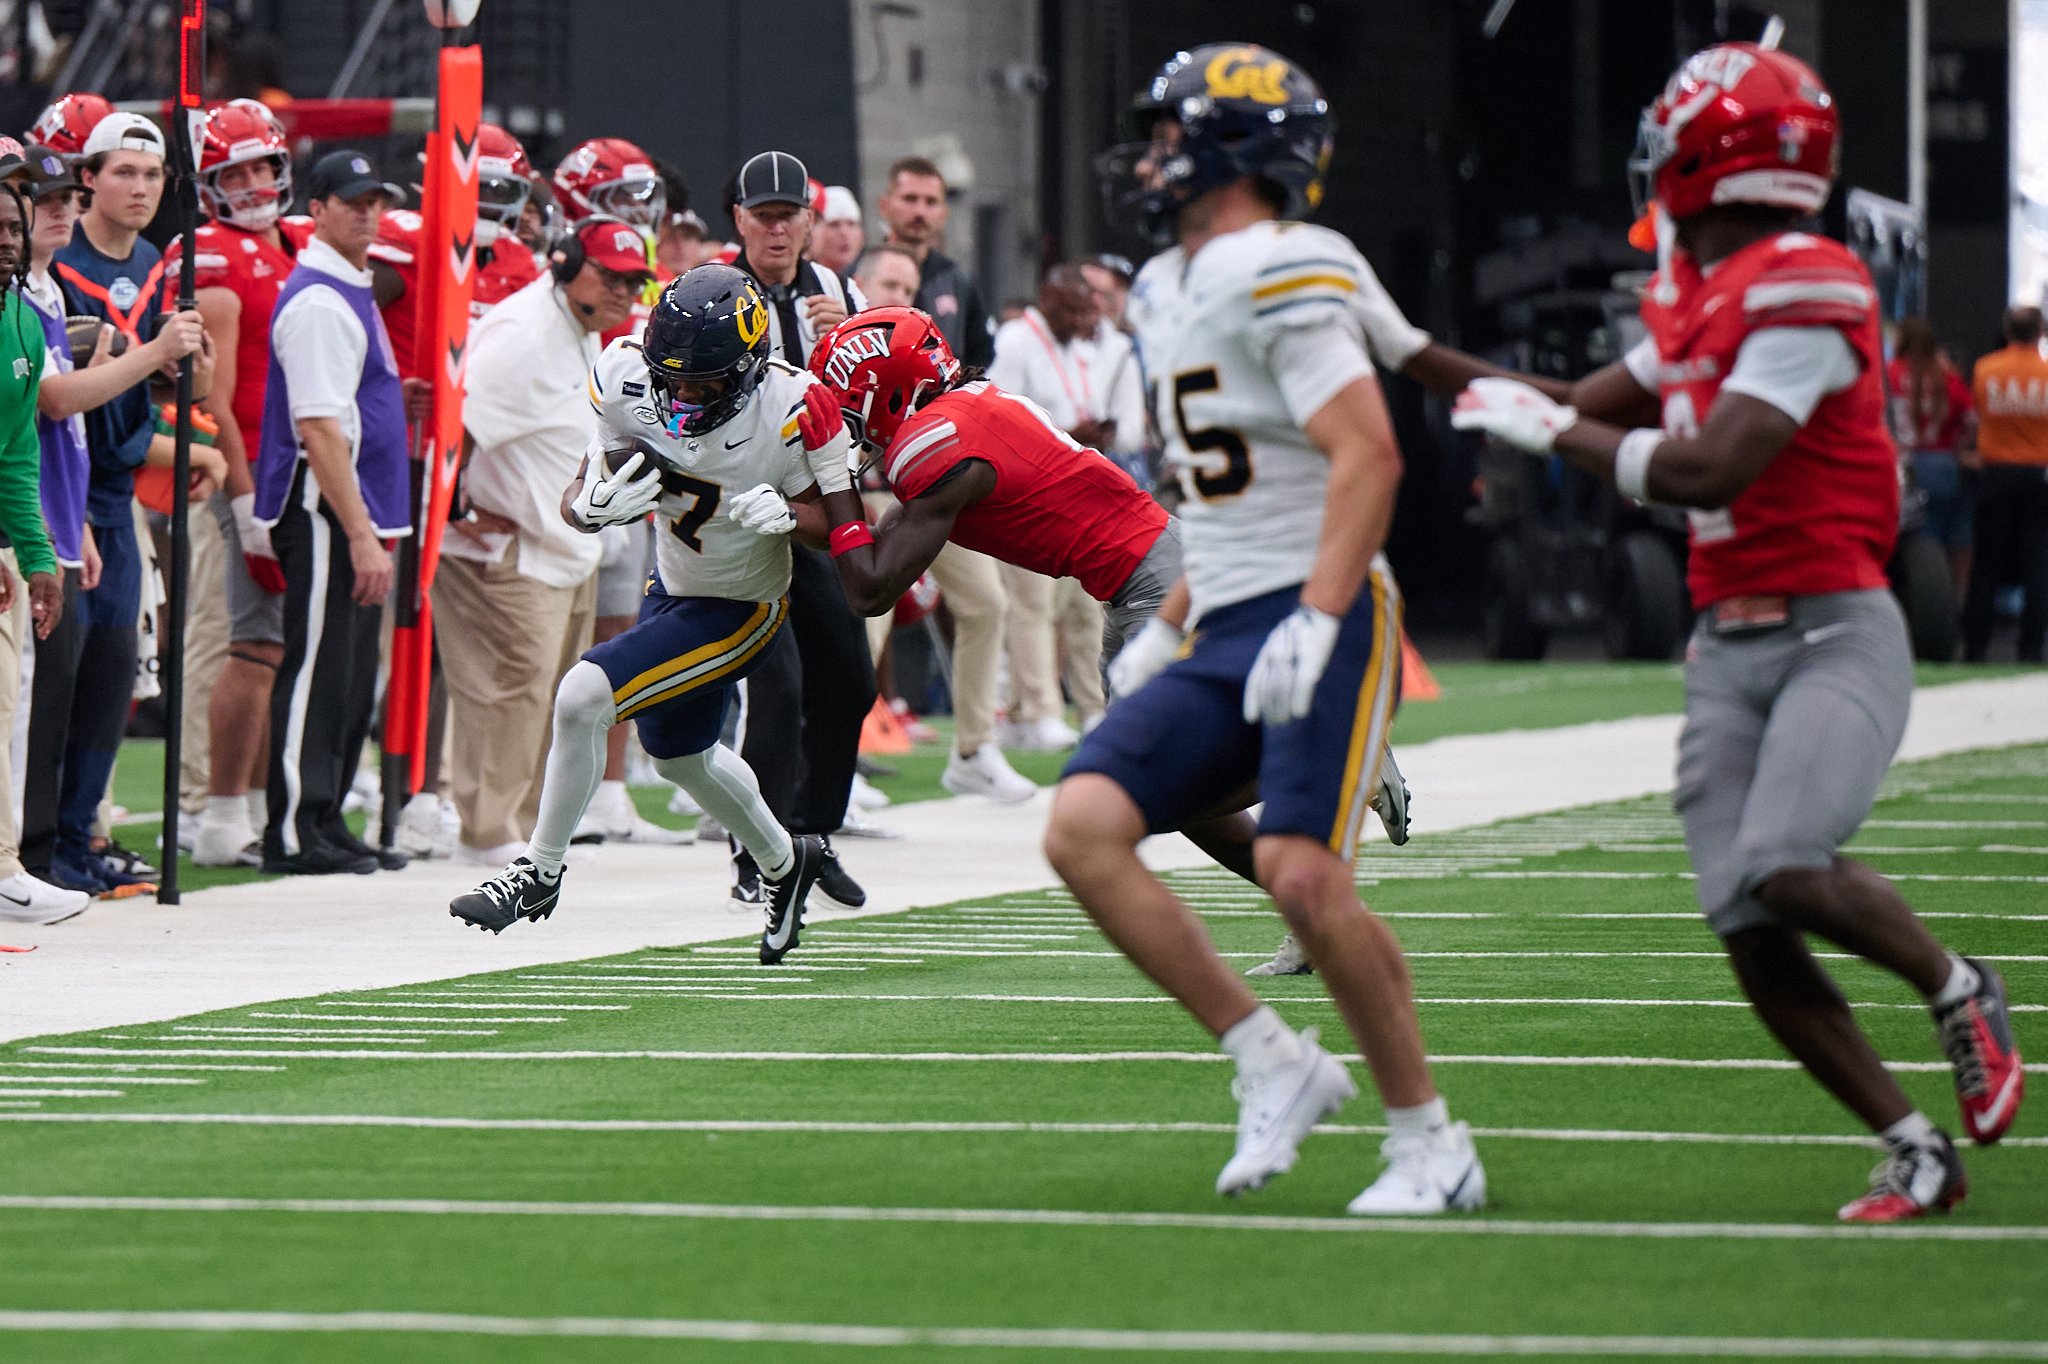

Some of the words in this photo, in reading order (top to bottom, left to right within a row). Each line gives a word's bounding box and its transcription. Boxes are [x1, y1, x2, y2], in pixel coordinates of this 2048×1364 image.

[736, 284, 768, 351] Cal
[825, 328, 891, 391] UNLV
[663, 470, 722, 555] 7
